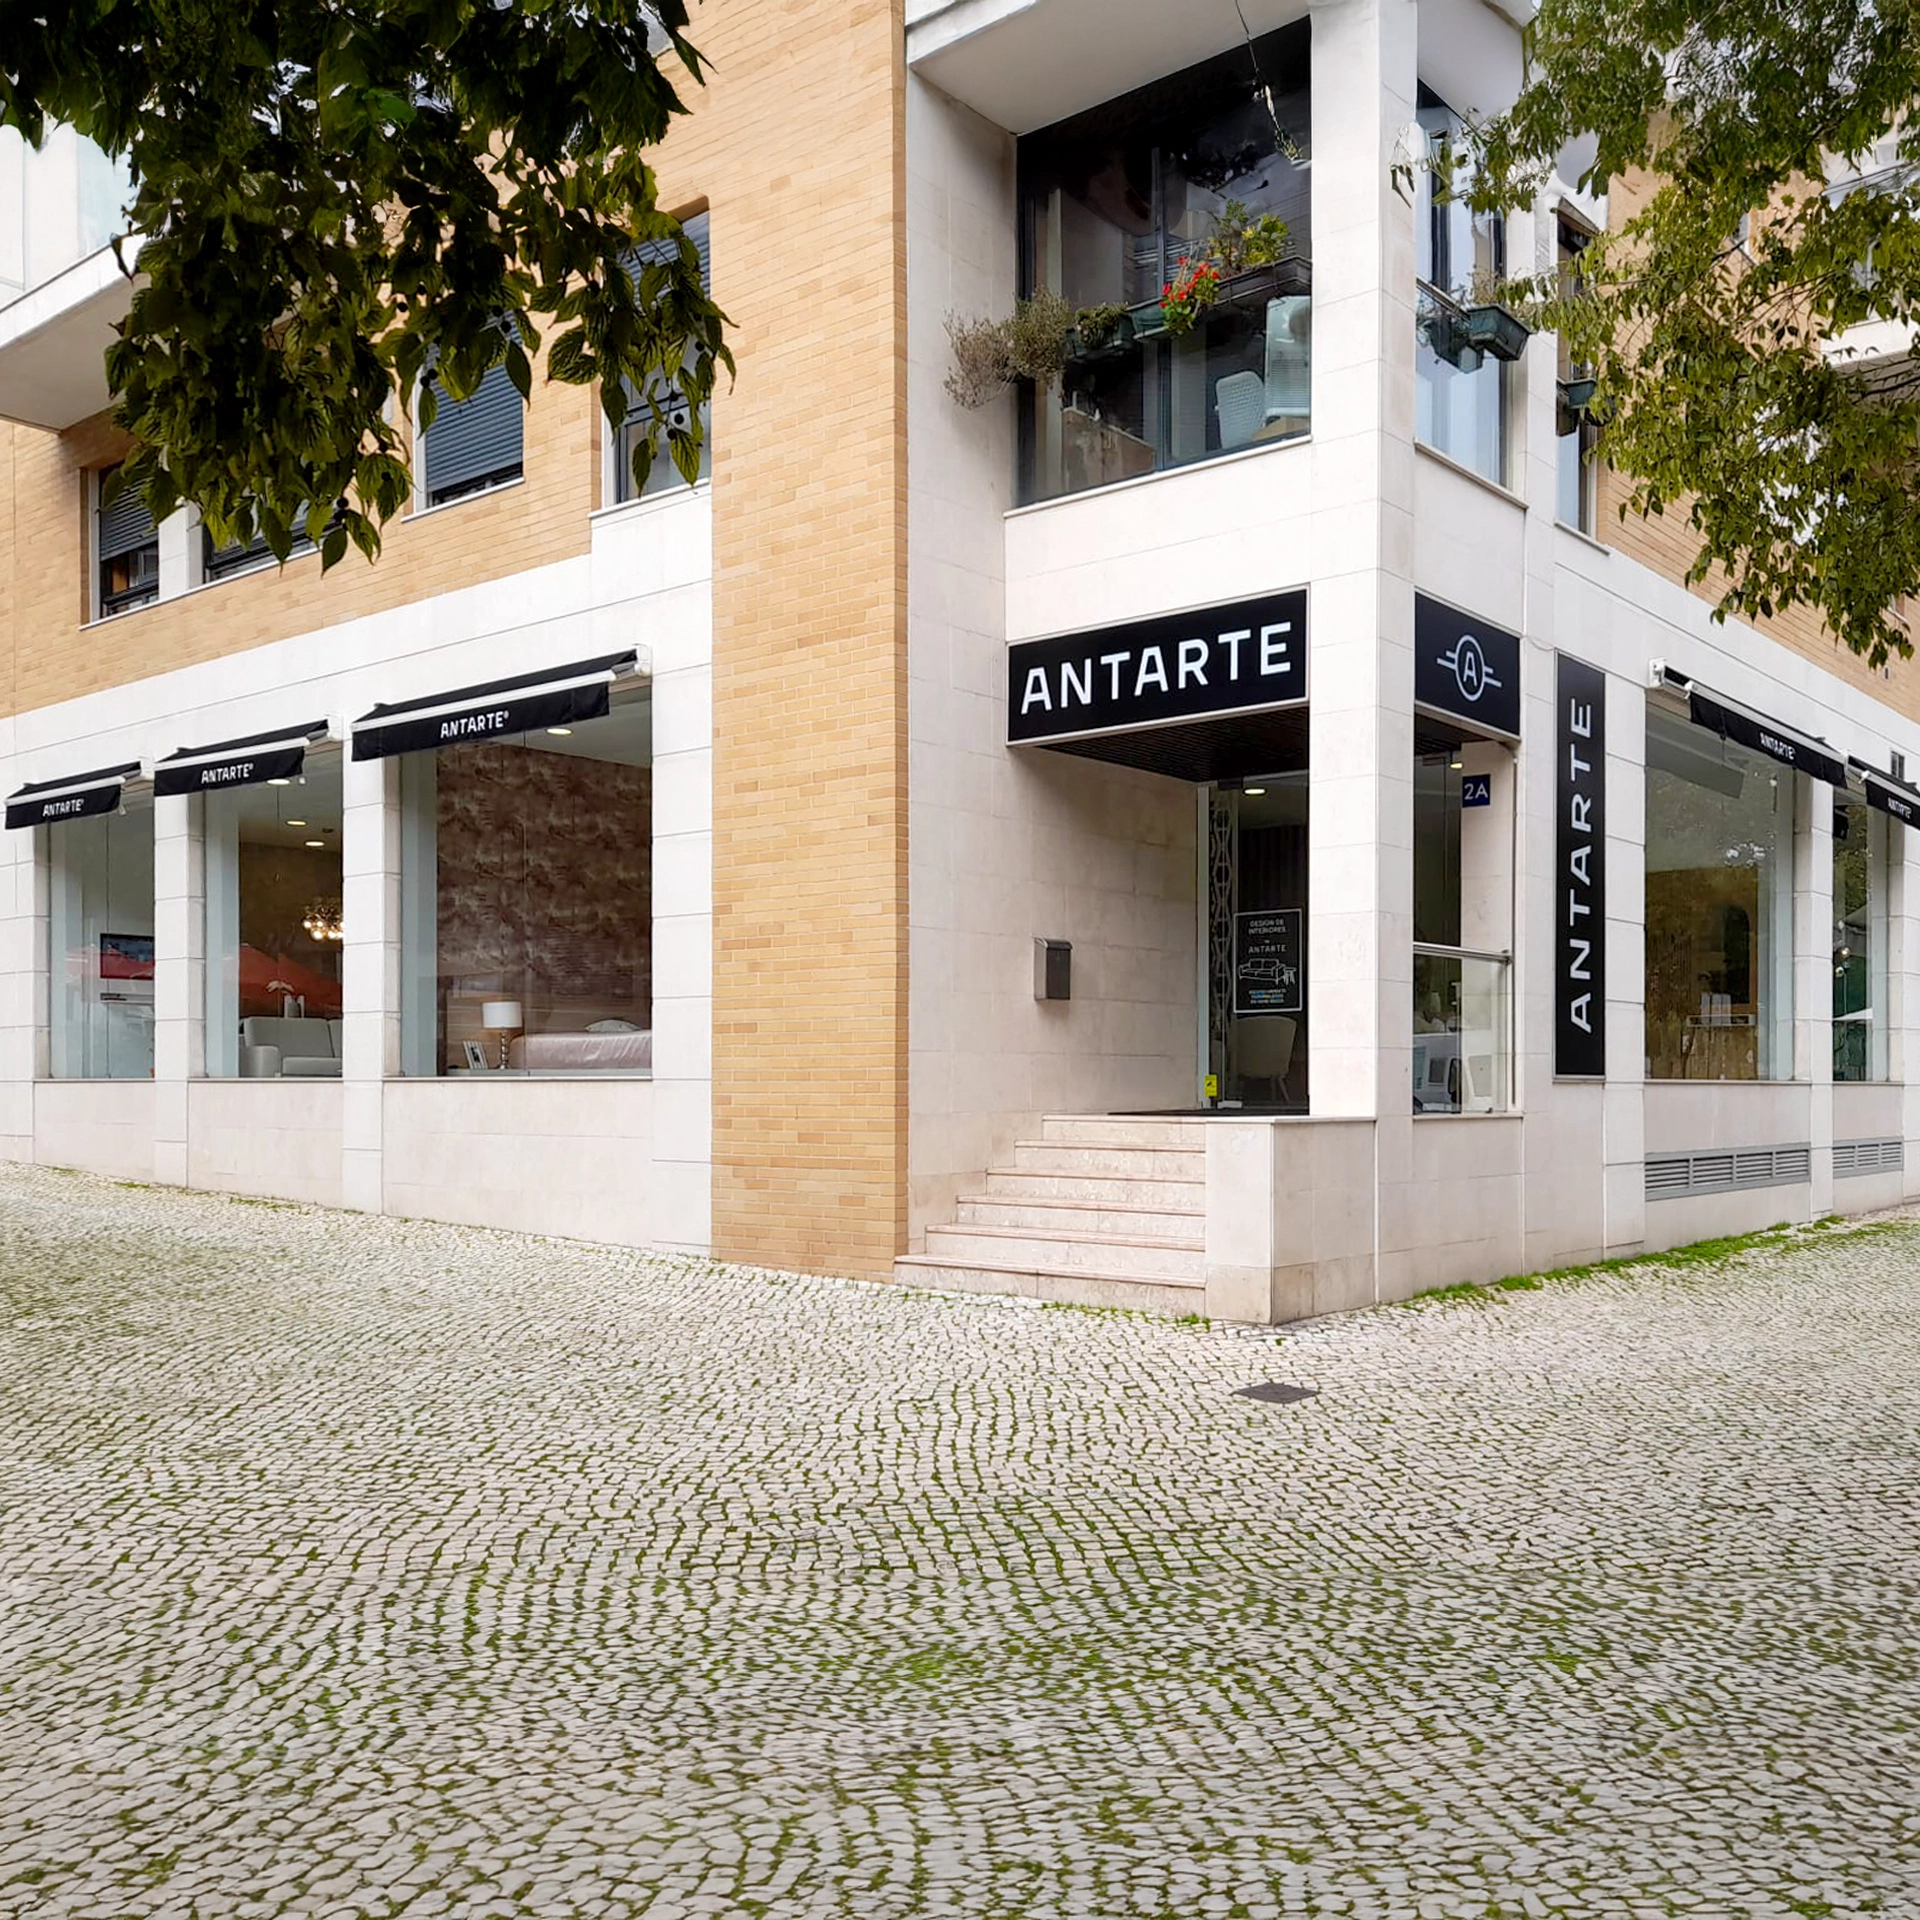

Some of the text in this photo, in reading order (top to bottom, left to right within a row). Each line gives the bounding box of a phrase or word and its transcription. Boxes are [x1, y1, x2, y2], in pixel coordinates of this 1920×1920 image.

[1021, 622, 1291, 715] ANTARTE
[1464, 782, 1488, 800] 2A
[1570, 698, 1592, 1033] ANTARTE
[1248, 944, 1286, 954] ANTARTE
